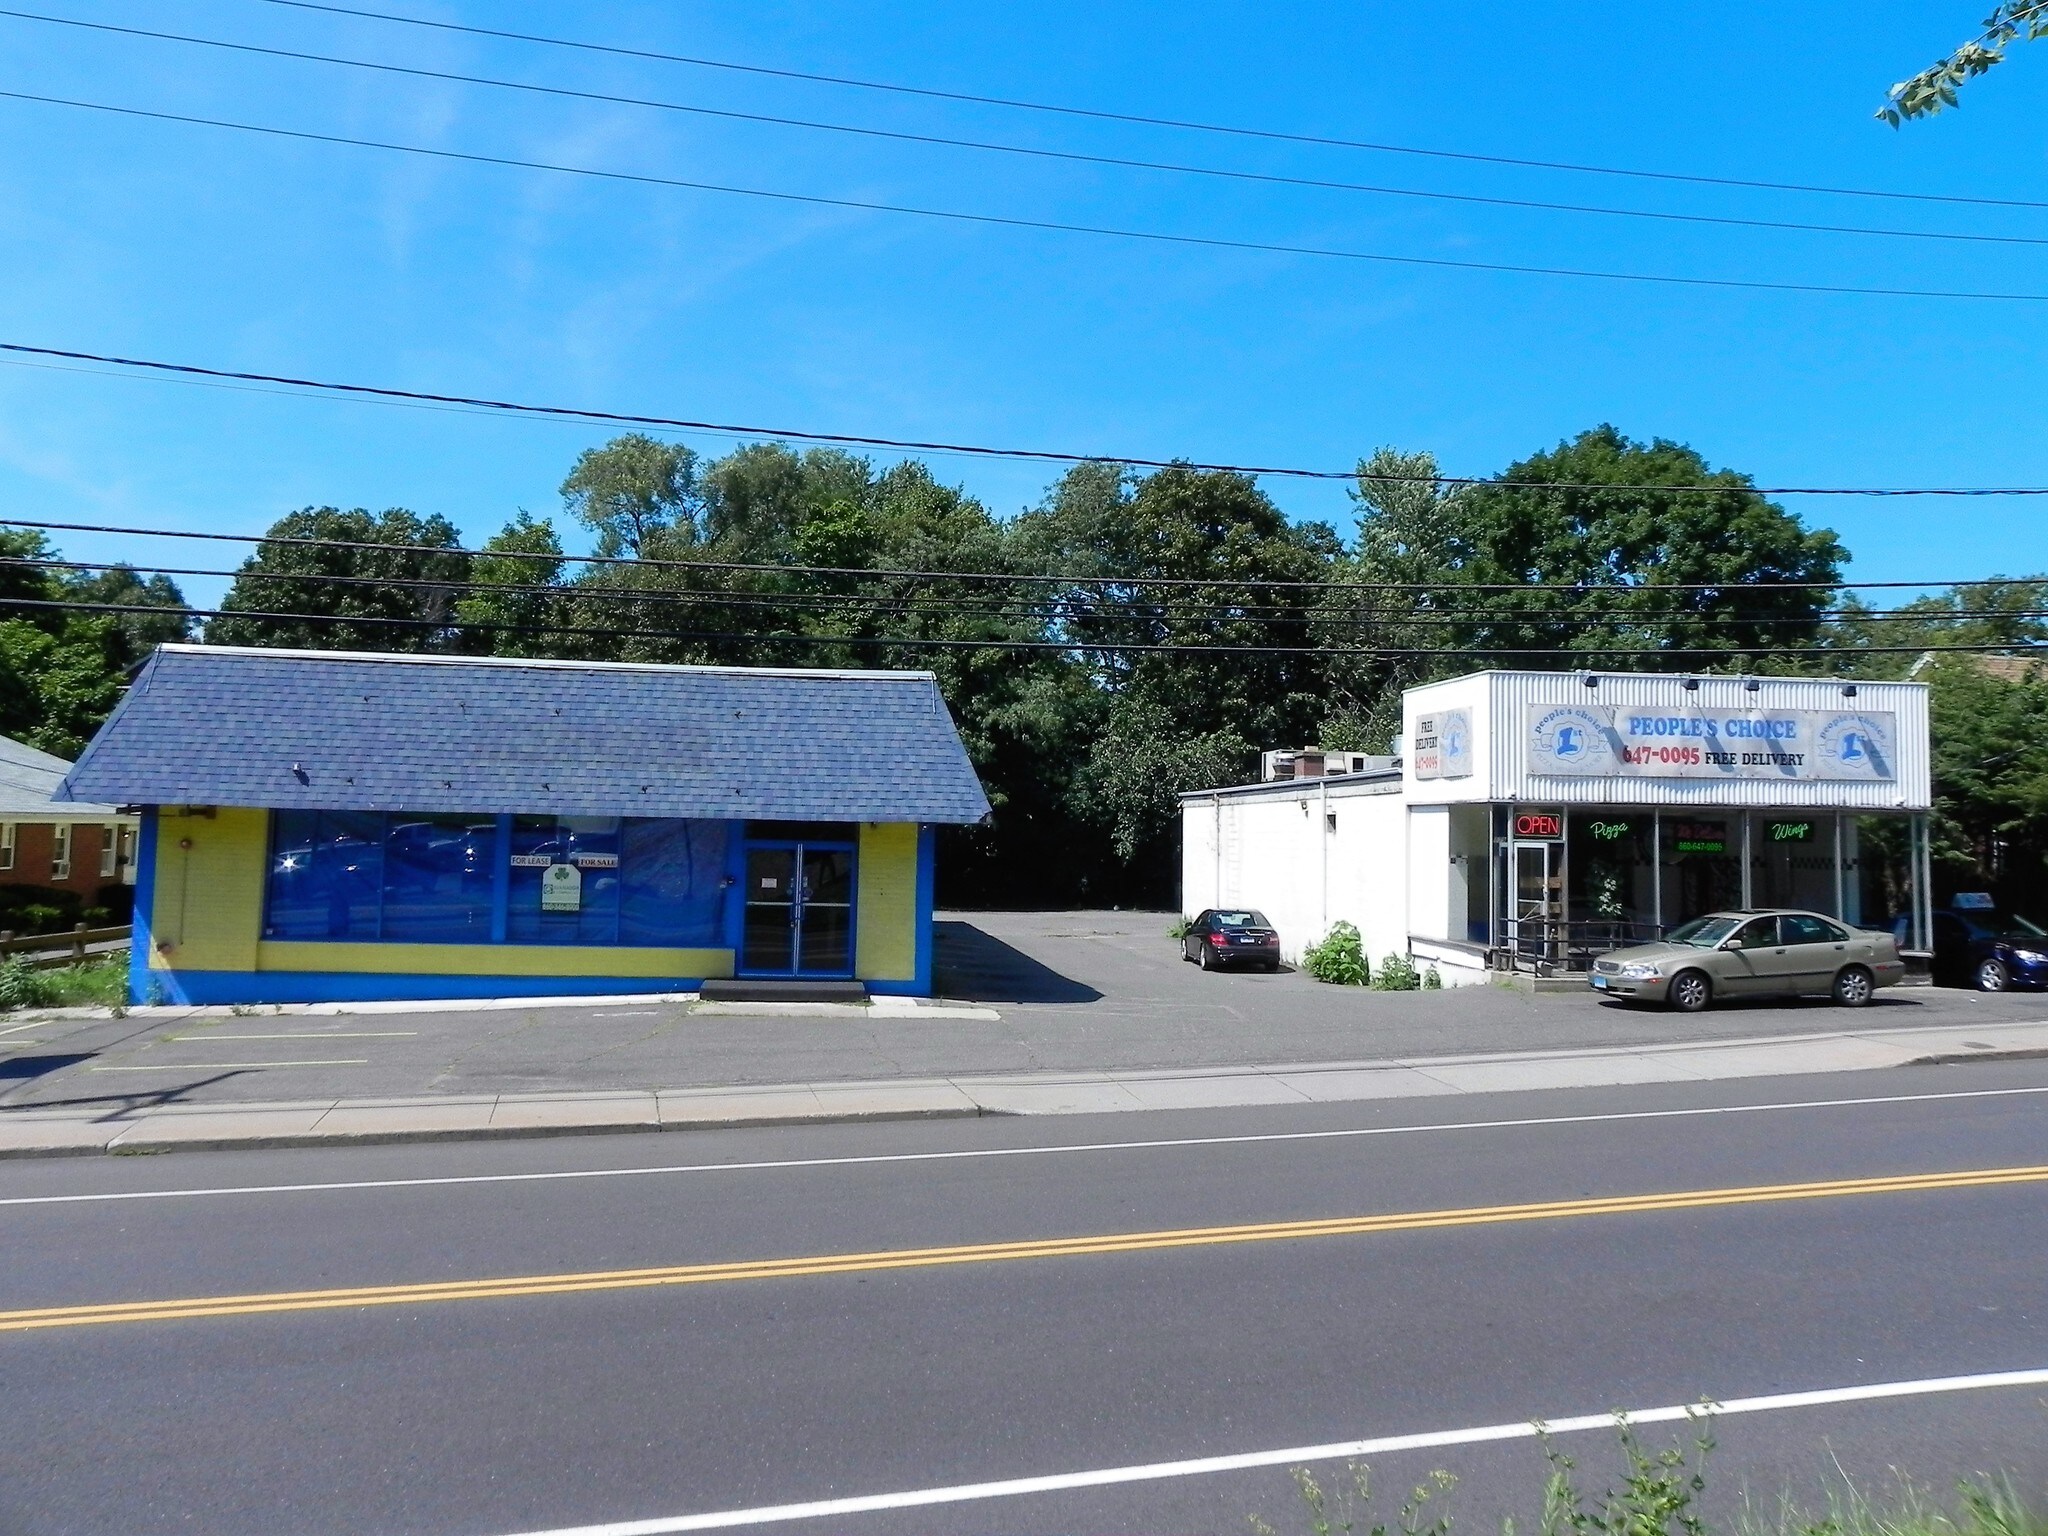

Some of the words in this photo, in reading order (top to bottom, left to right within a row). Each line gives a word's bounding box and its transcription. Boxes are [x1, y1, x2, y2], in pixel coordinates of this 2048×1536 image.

[1421, 721, 1433, 733] FREE
[1575, 710, 1604, 735] choice
[1629, 717, 1718, 738] PEOPLE'S
[1725, 719, 1797, 739] CHOICE
[1416, 736, 1438, 750] DELIVERY
[1623, 745, 1700, 765] 647-0095
[1705, 752, 1737, 765] FREE
[1742, 753, 1805, 766] DELIVERY
[1517, 816, 1559, 834] OPEN
[1590, 821, 1628, 839] Pizza
[1772, 823, 1808, 840] Wings
[528, 857, 549, 865] LEASE
